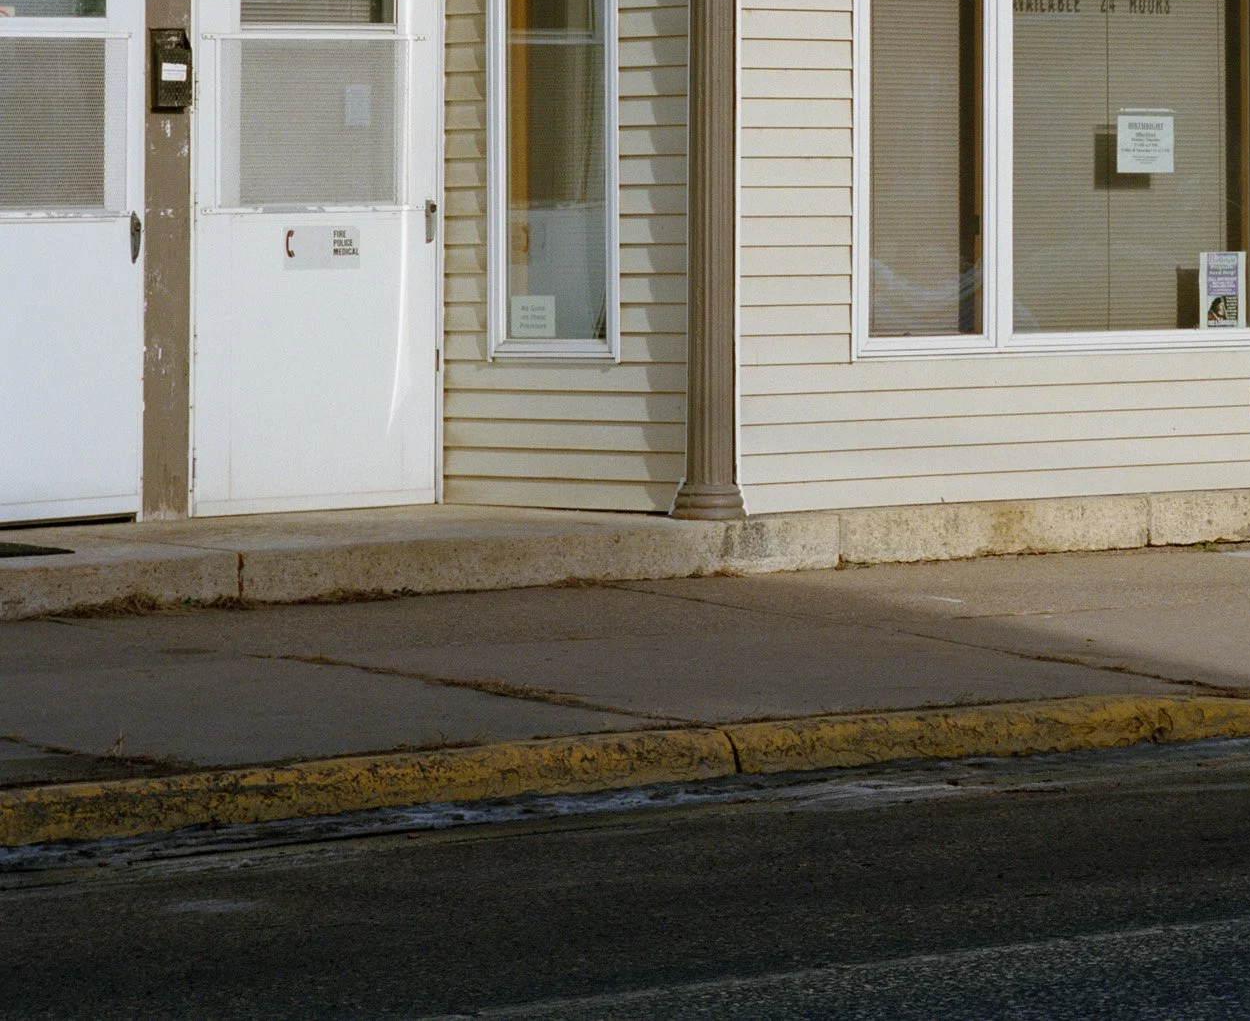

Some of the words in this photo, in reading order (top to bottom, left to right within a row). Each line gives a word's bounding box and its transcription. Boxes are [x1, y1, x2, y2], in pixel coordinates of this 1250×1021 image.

[333, 230, 346, 238] FIRE
[333, 239, 353, 247] POLICE
[333, 248, 359, 256] MEDICAL
